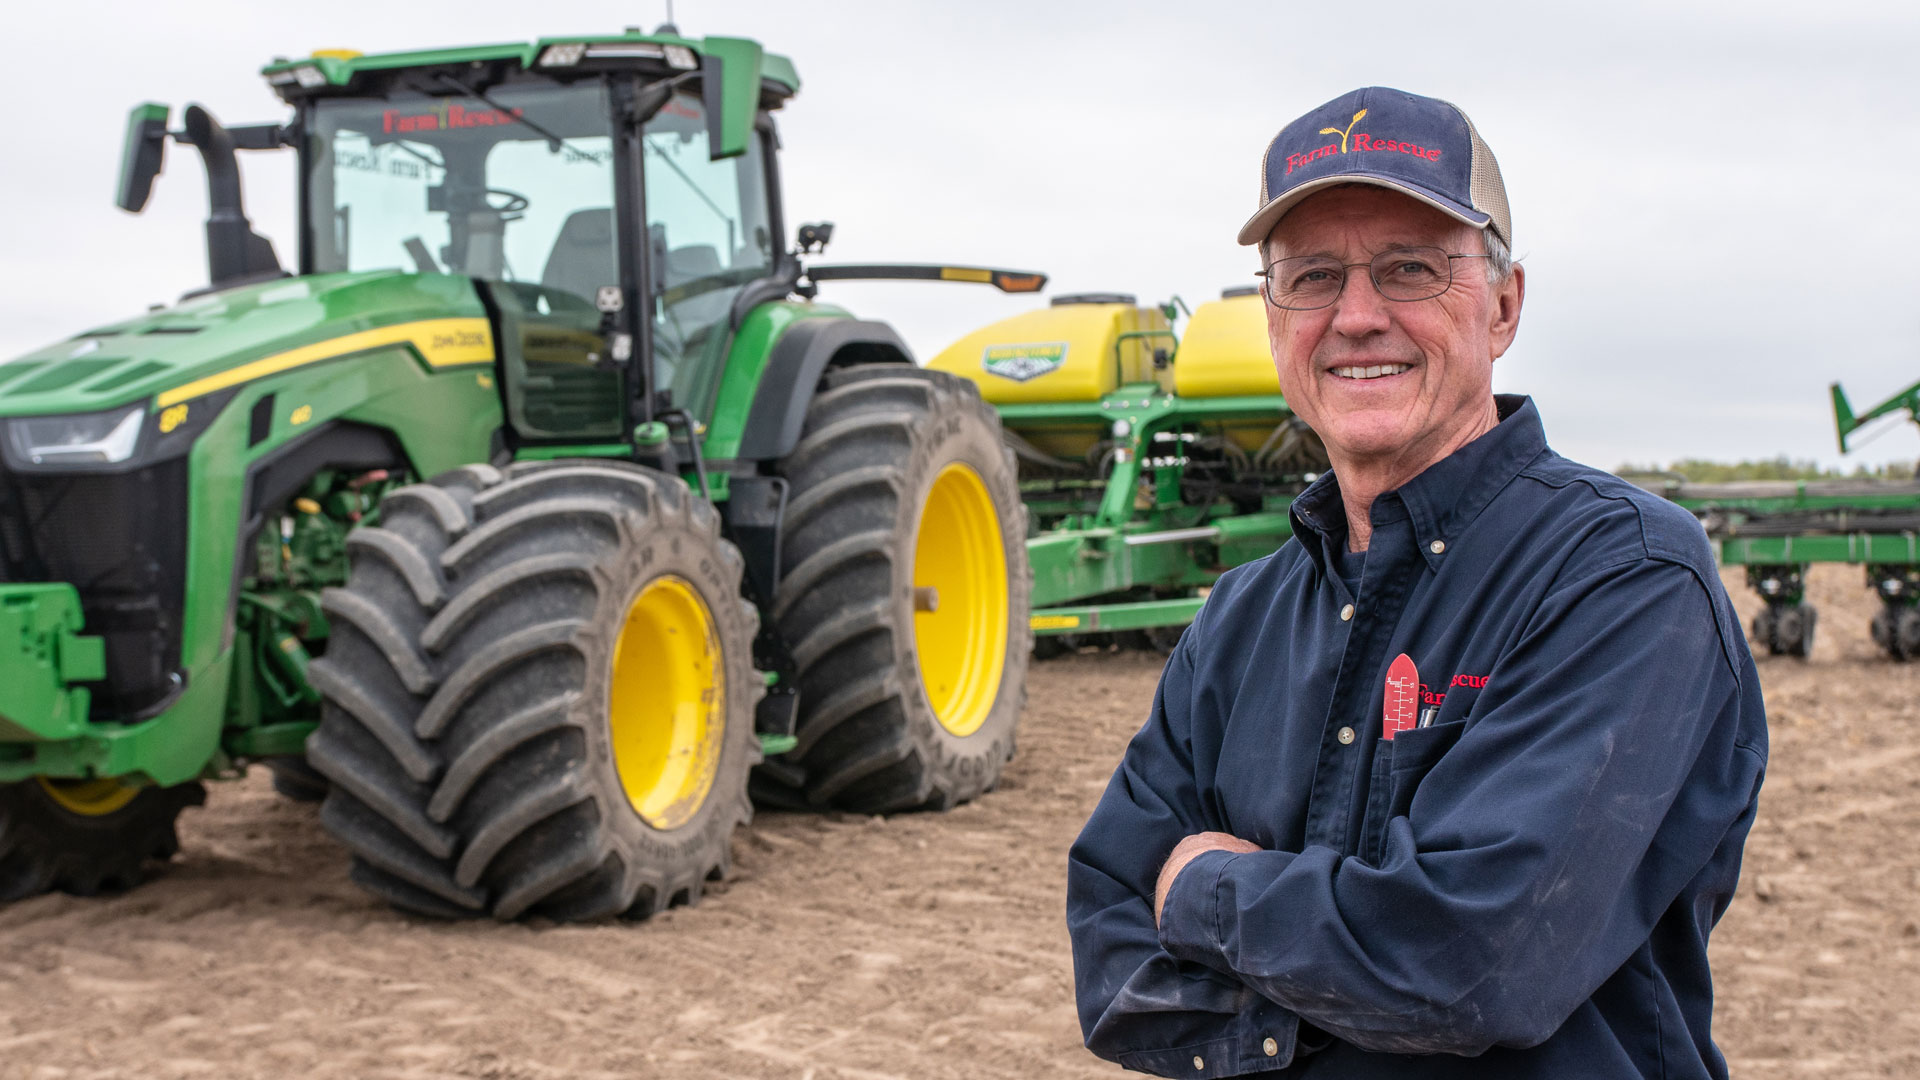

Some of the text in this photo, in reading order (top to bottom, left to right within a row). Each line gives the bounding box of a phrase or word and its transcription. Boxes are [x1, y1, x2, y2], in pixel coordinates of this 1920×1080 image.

[383, 109, 438, 134] Farm
[1285, 133, 1442, 176] Farm Rescue
